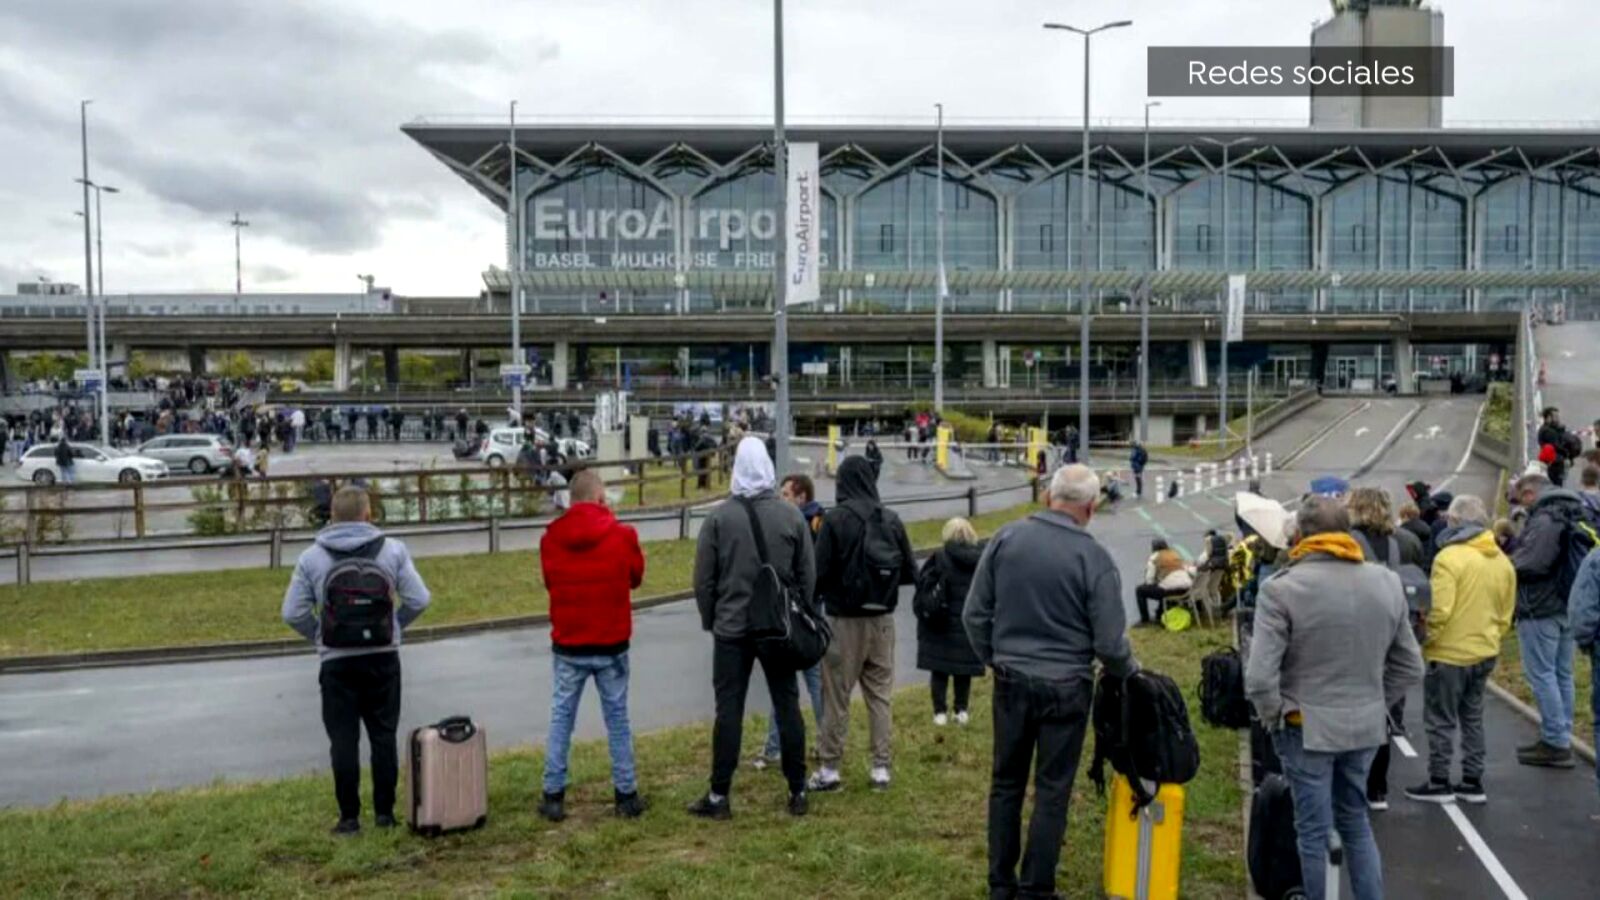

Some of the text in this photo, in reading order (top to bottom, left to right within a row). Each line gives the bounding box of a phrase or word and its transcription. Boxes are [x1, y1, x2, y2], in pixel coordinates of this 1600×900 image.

[535, 252, 829, 268] BASEL MULHOSE FREIG
